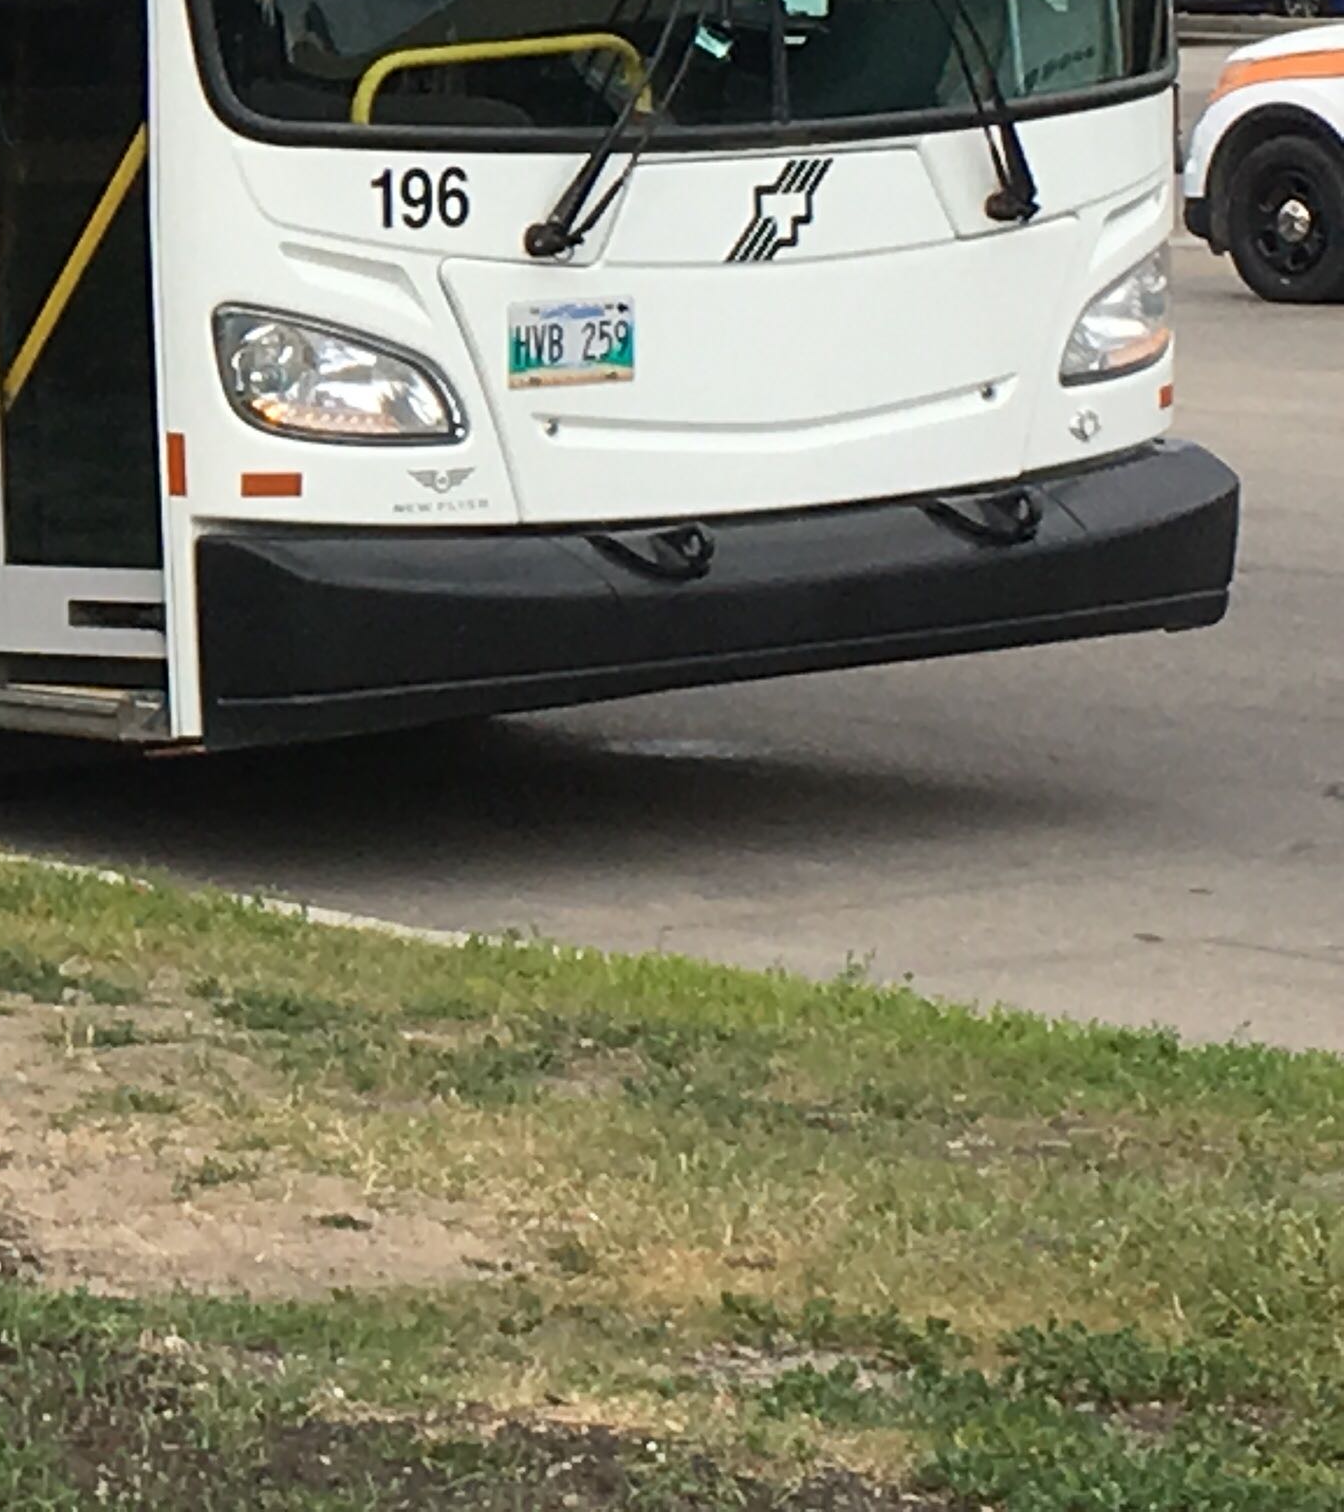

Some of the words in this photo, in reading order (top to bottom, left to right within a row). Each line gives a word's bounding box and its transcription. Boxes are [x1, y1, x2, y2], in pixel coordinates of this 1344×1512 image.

[371, 166, 470, 230] 196
[515, 323, 563, 367] HVB
[581, 320, 629, 361] 259
